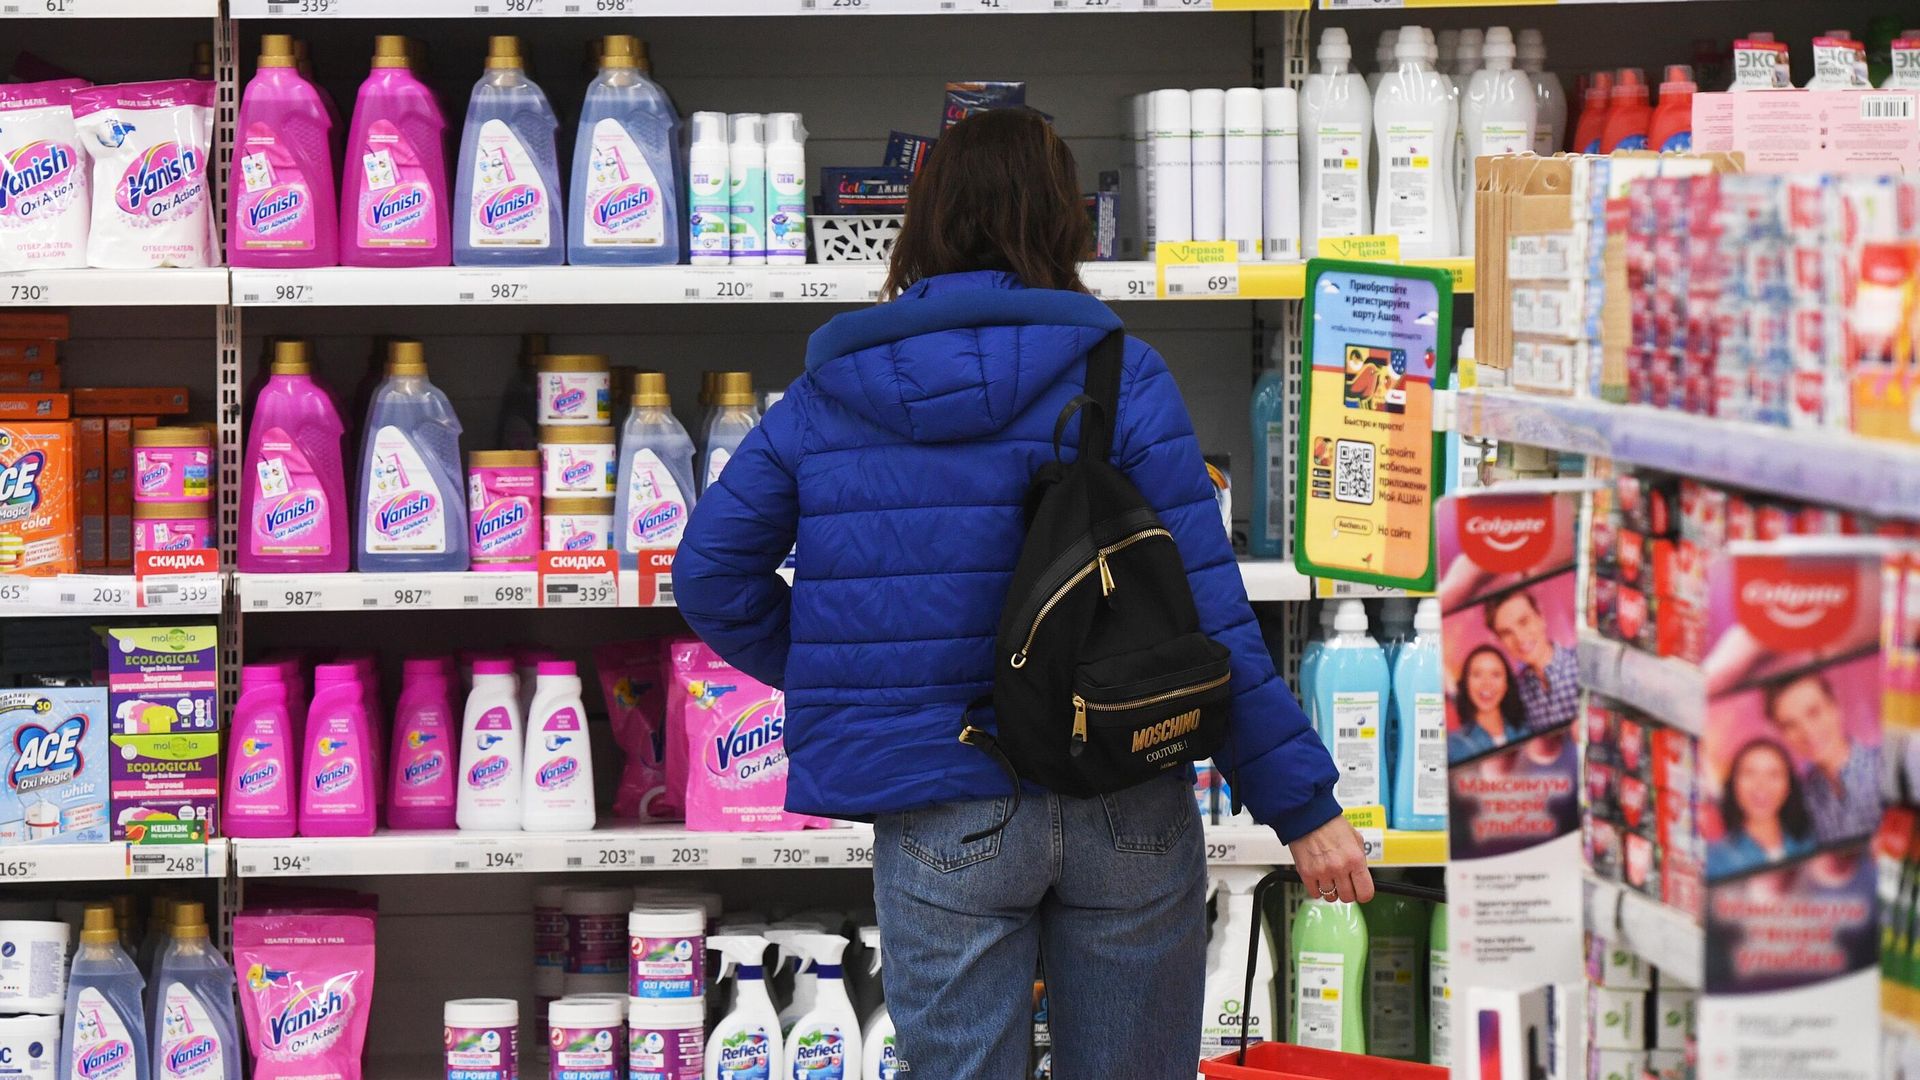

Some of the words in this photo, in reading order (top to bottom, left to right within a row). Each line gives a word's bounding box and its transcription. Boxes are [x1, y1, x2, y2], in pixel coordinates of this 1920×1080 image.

[128, 149, 196, 208] Vanish
[21, 197, 41, 216] Oxi
[152, 198, 171, 217] Oxi
[172, 184, 201, 208] Action
[250, 189, 298, 226] Vanish
[374, 188, 421, 224] Vanish
[486, 187, 534, 224] Vanish
[600, 187, 648, 223] Vanish
[490, 284, 519, 298] 987
[716, 282, 745, 297] 210
[801, 282, 829, 297] 152
[1128, 280, 1146, 295] 91
[1208, 275, 1228, 291] 69
[1350, 279, 1408, 295] Приобретайте
[11, 285, 41, 300] 730
[275, 285, 303, 300] 987
[1352, 294, 1410, 311] регистрируйте
[1352, 310, 1376, 322] карту
[1344, 415, 1371, 429] Быстро
[1380, 444, 1416, 459] Скачайте
[266, 497, 315, 532] Vanish
[381, 496, 429, 530] Vanish
[638, 506, 678, 535] Vanish
[21, 515, 53, 530] color
[287, 517, 315, 534] ADVANCE
[402, 516, 429, 532] ADVANCE
[475, 502, 523, 544] Vanish
[1466, 516, 1545, 535] Colgate
[494, 527, 523, 545] ADVANCE
[148, 554, 205, 569] СКИДКА
[550, 555, 606, 570] СКИДКА
[93, 588, 122, 602] 203
[180, 587, 207, 601] 339
[285, 591, 313, 605] 987
[394, 590, 422, 604] 987
[495, 587, 524, 601] 698
[579, 587, 607, 602] 339
[125, 654, 199, 666] ECOLOGICAL
[36, 701, 51, 711] 30
[1131, 707, 1200, 753] MOSCHINO
[15, 726, 80, 772] ACE
[716, 716, 784, 770] Vanis
[1146, 742, 1184, 763] COUTURE
[127, 761, 202, 772] ECOLOGICAL
[404, 756, 439, 780] Vanish
[472, 758, 505, 782] Vanish
[541, 759, 575, 783] Vanish
[740, 761, 761, 779] Oxi
[763, 752, 789, 771] Acti
[21, 777, 39, 789] Oxi
[40, 775, 68, 787] Magic
[239, 764, 274, 789] Vanish
[315, 763, 350, 788] Vanish
[61, 781, 95, 798] white
[1457, 777, 1571, 798] Максимум
[1484, 795, 1547, 813] твоей
[151, 824, 188, 833] КЕШБЭК
[1473, 815, 1556, 838] улыбки
[486, 852, 514, 867] 194
[599, 849, 627, 864] 203
[672, 849, 700, 863] 203
[773, 848, 802, 863] 730
[846, 847, 873, 862] 396
[0, 862, 28, 876] 165
[166, 857, 195, 872] 248
[273, 855, 301, 871] 194
[643, 980, 658, 990] OXI
[658, 980, 691, 990] POWER
[271, 991, 342, 1045] Vanish
[1218, 1013, 1260, 1026] Cotco
[83, 1041, 124, 1075] Vanish
[170, 1036, 211, 1069] Vanish
[722, 1043, 768, 1062] Reflect
[797, 1043, 842, 1061] Reflect
[450, 1071, 465, 1079] OXI
[466, 1070, 498, 1079] POWER
[562, 1071, 578, 1080] OXI
[579, 1071, 610, 1079] POWER
